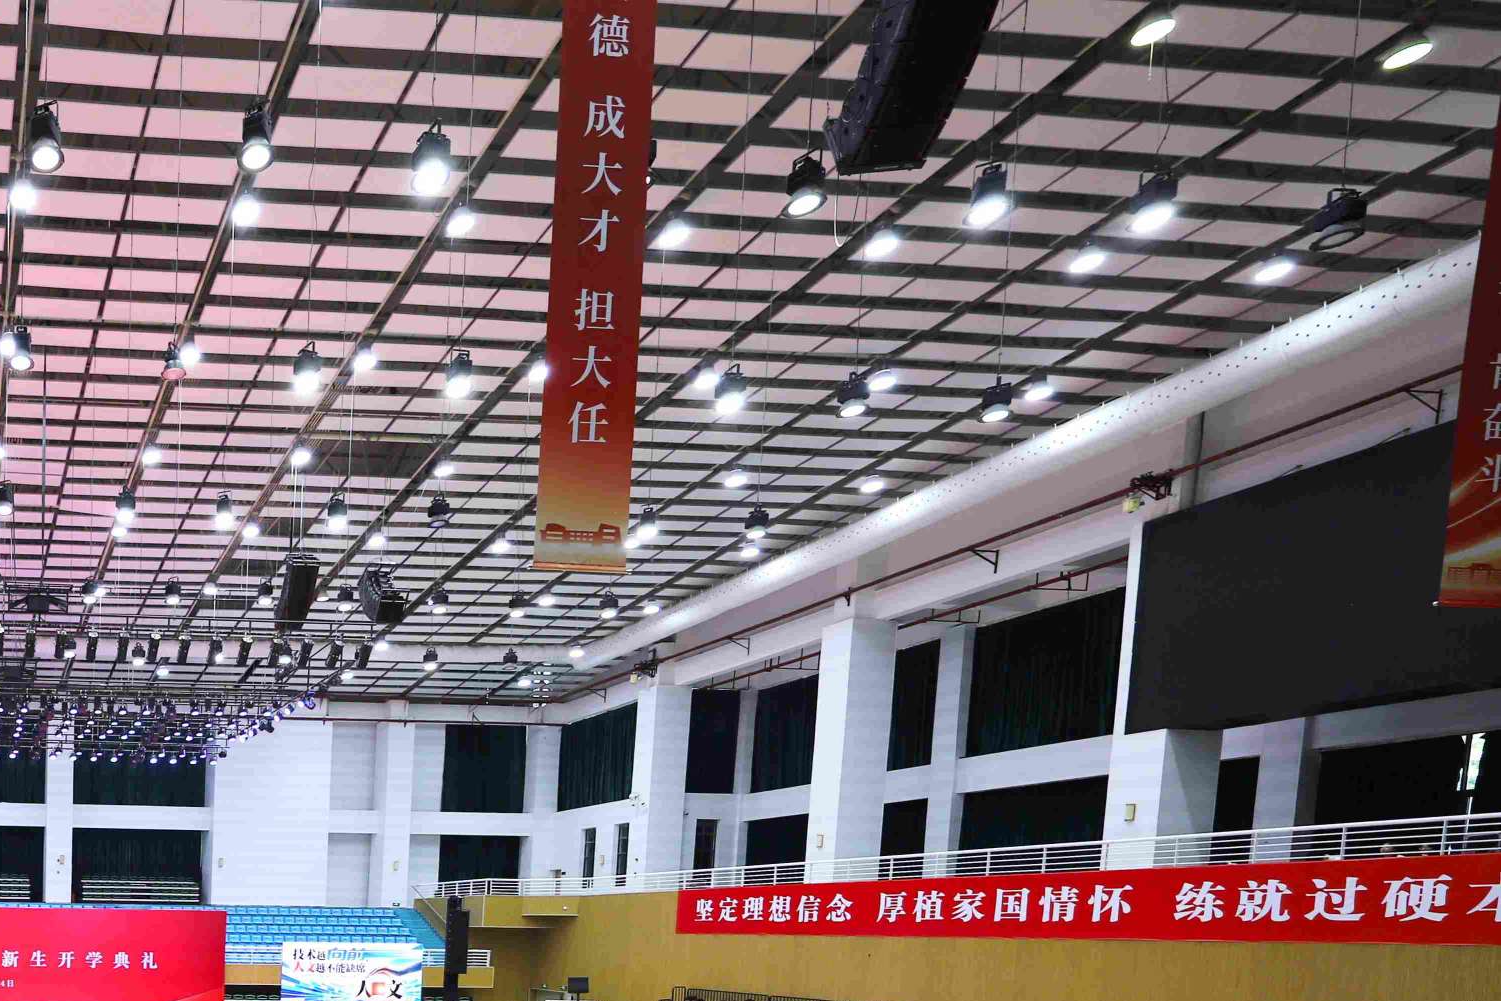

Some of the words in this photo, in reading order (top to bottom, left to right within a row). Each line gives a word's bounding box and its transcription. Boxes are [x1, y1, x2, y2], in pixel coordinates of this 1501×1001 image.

[589, 13, 630, 57] 德
[579, 95, 625, 252] 成大才
[568, 288, 614, 443] 担大任
[695, 893, 854, 924] 坚定理想信念
[875, 884, 1135, 924] 厚植家国情怀
